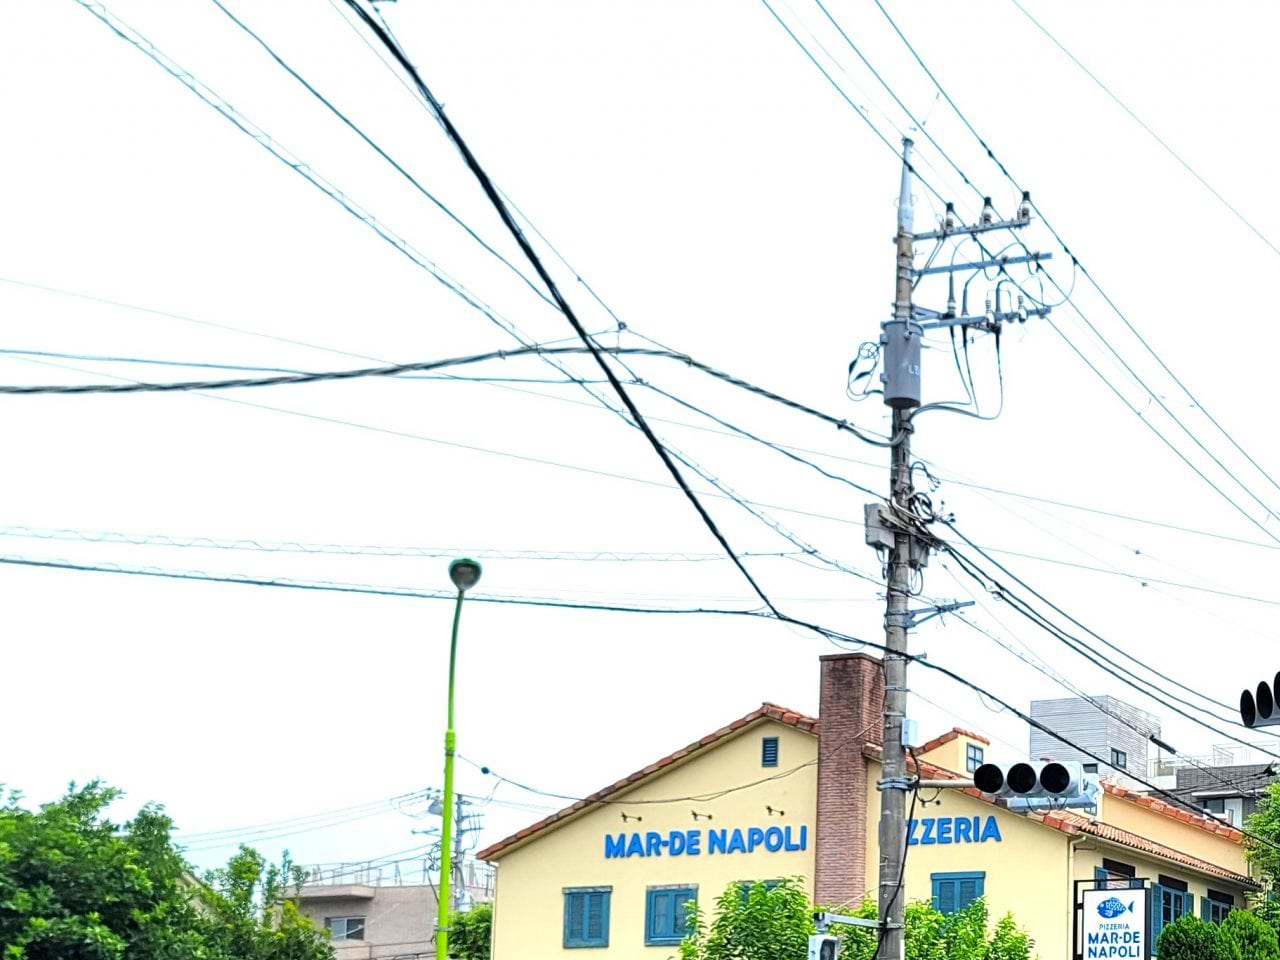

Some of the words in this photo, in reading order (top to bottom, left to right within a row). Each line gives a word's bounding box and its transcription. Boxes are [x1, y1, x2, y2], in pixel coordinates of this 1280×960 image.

[605, 830, 701, 859] MAR-DE
[708, 825, 808, 855] NAPOLI
[904, 815, 1002, 846] ZZERIA
[1088, 945, 1140, 958] NAPOLI
